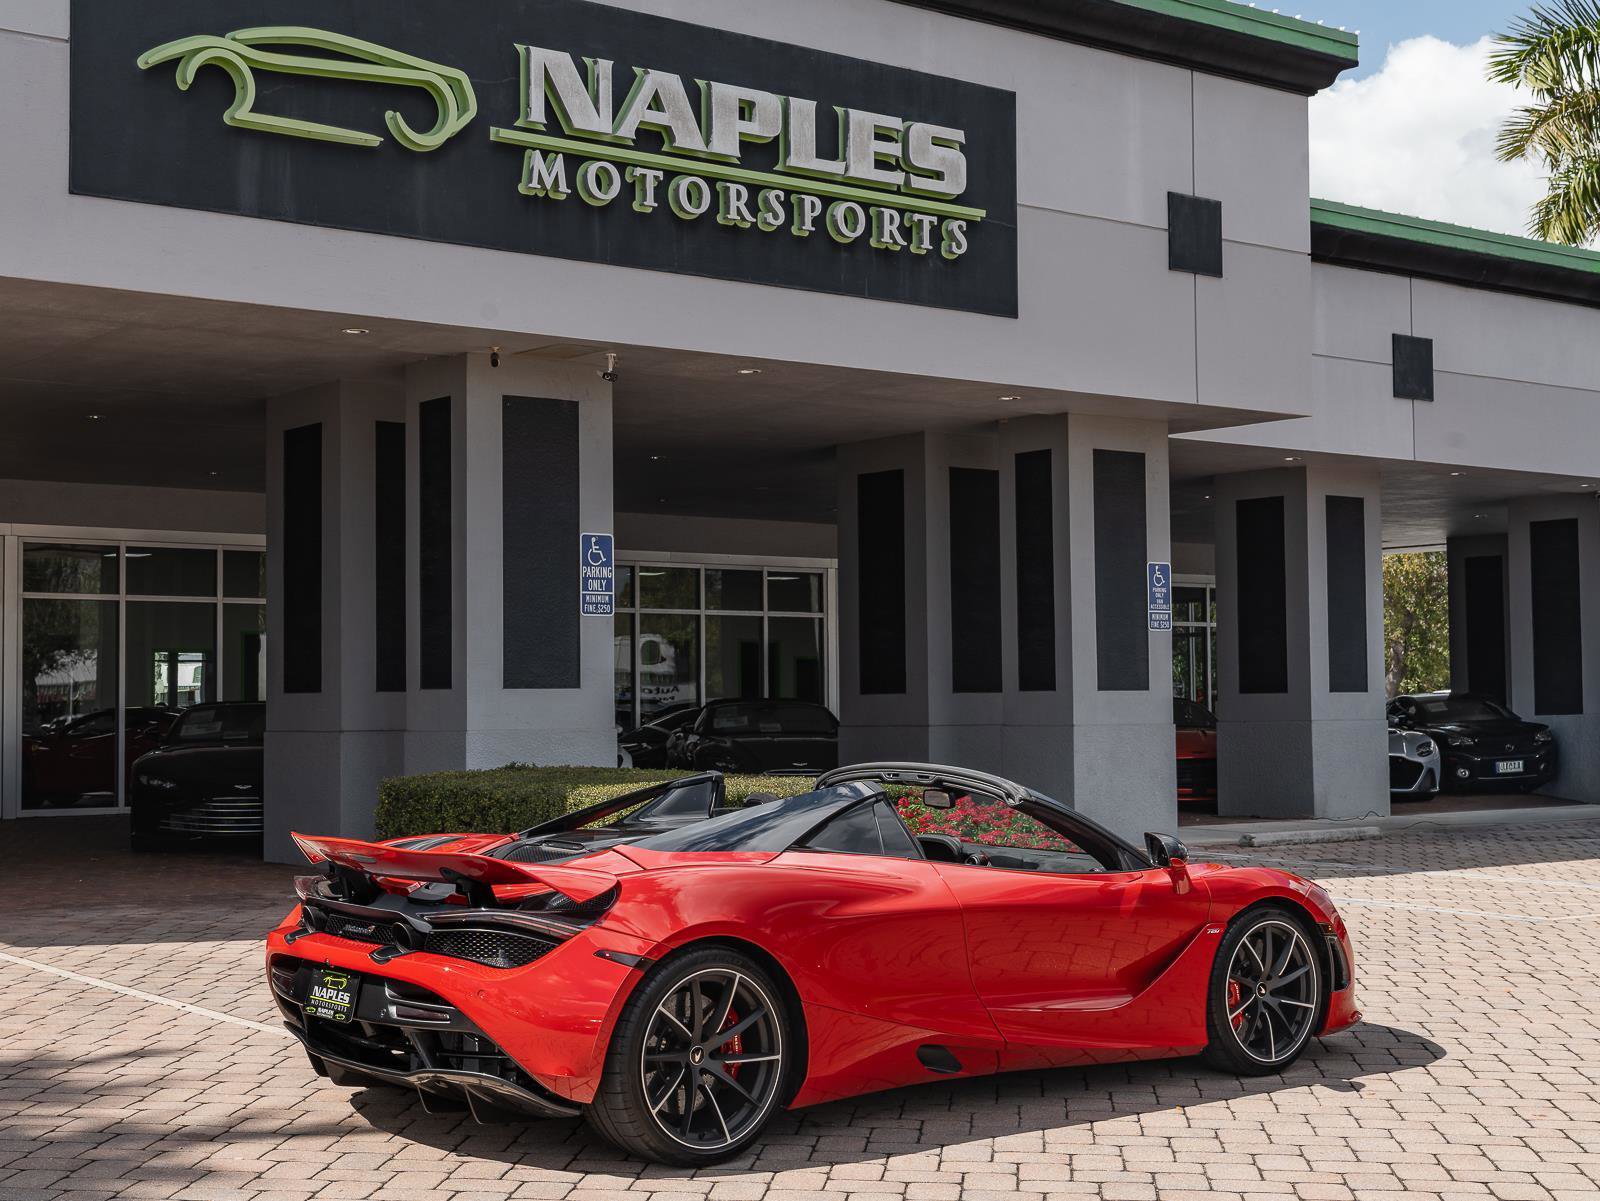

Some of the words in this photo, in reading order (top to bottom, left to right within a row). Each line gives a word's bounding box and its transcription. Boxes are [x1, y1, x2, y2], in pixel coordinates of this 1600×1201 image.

[515, 43, 968, 198] NAPLES
[518, 149, 969, 259] MOTORSPORTS
[582, 566, 612, 578] PARKING
[588, 579, 607, 591] ONLY
[585, 594, 609, 603] MINIMUM
[584, 604, 596, 613] FINE
[597, 604, 611, 613] $250
[312, 985, 351, 1004] NAPLES
